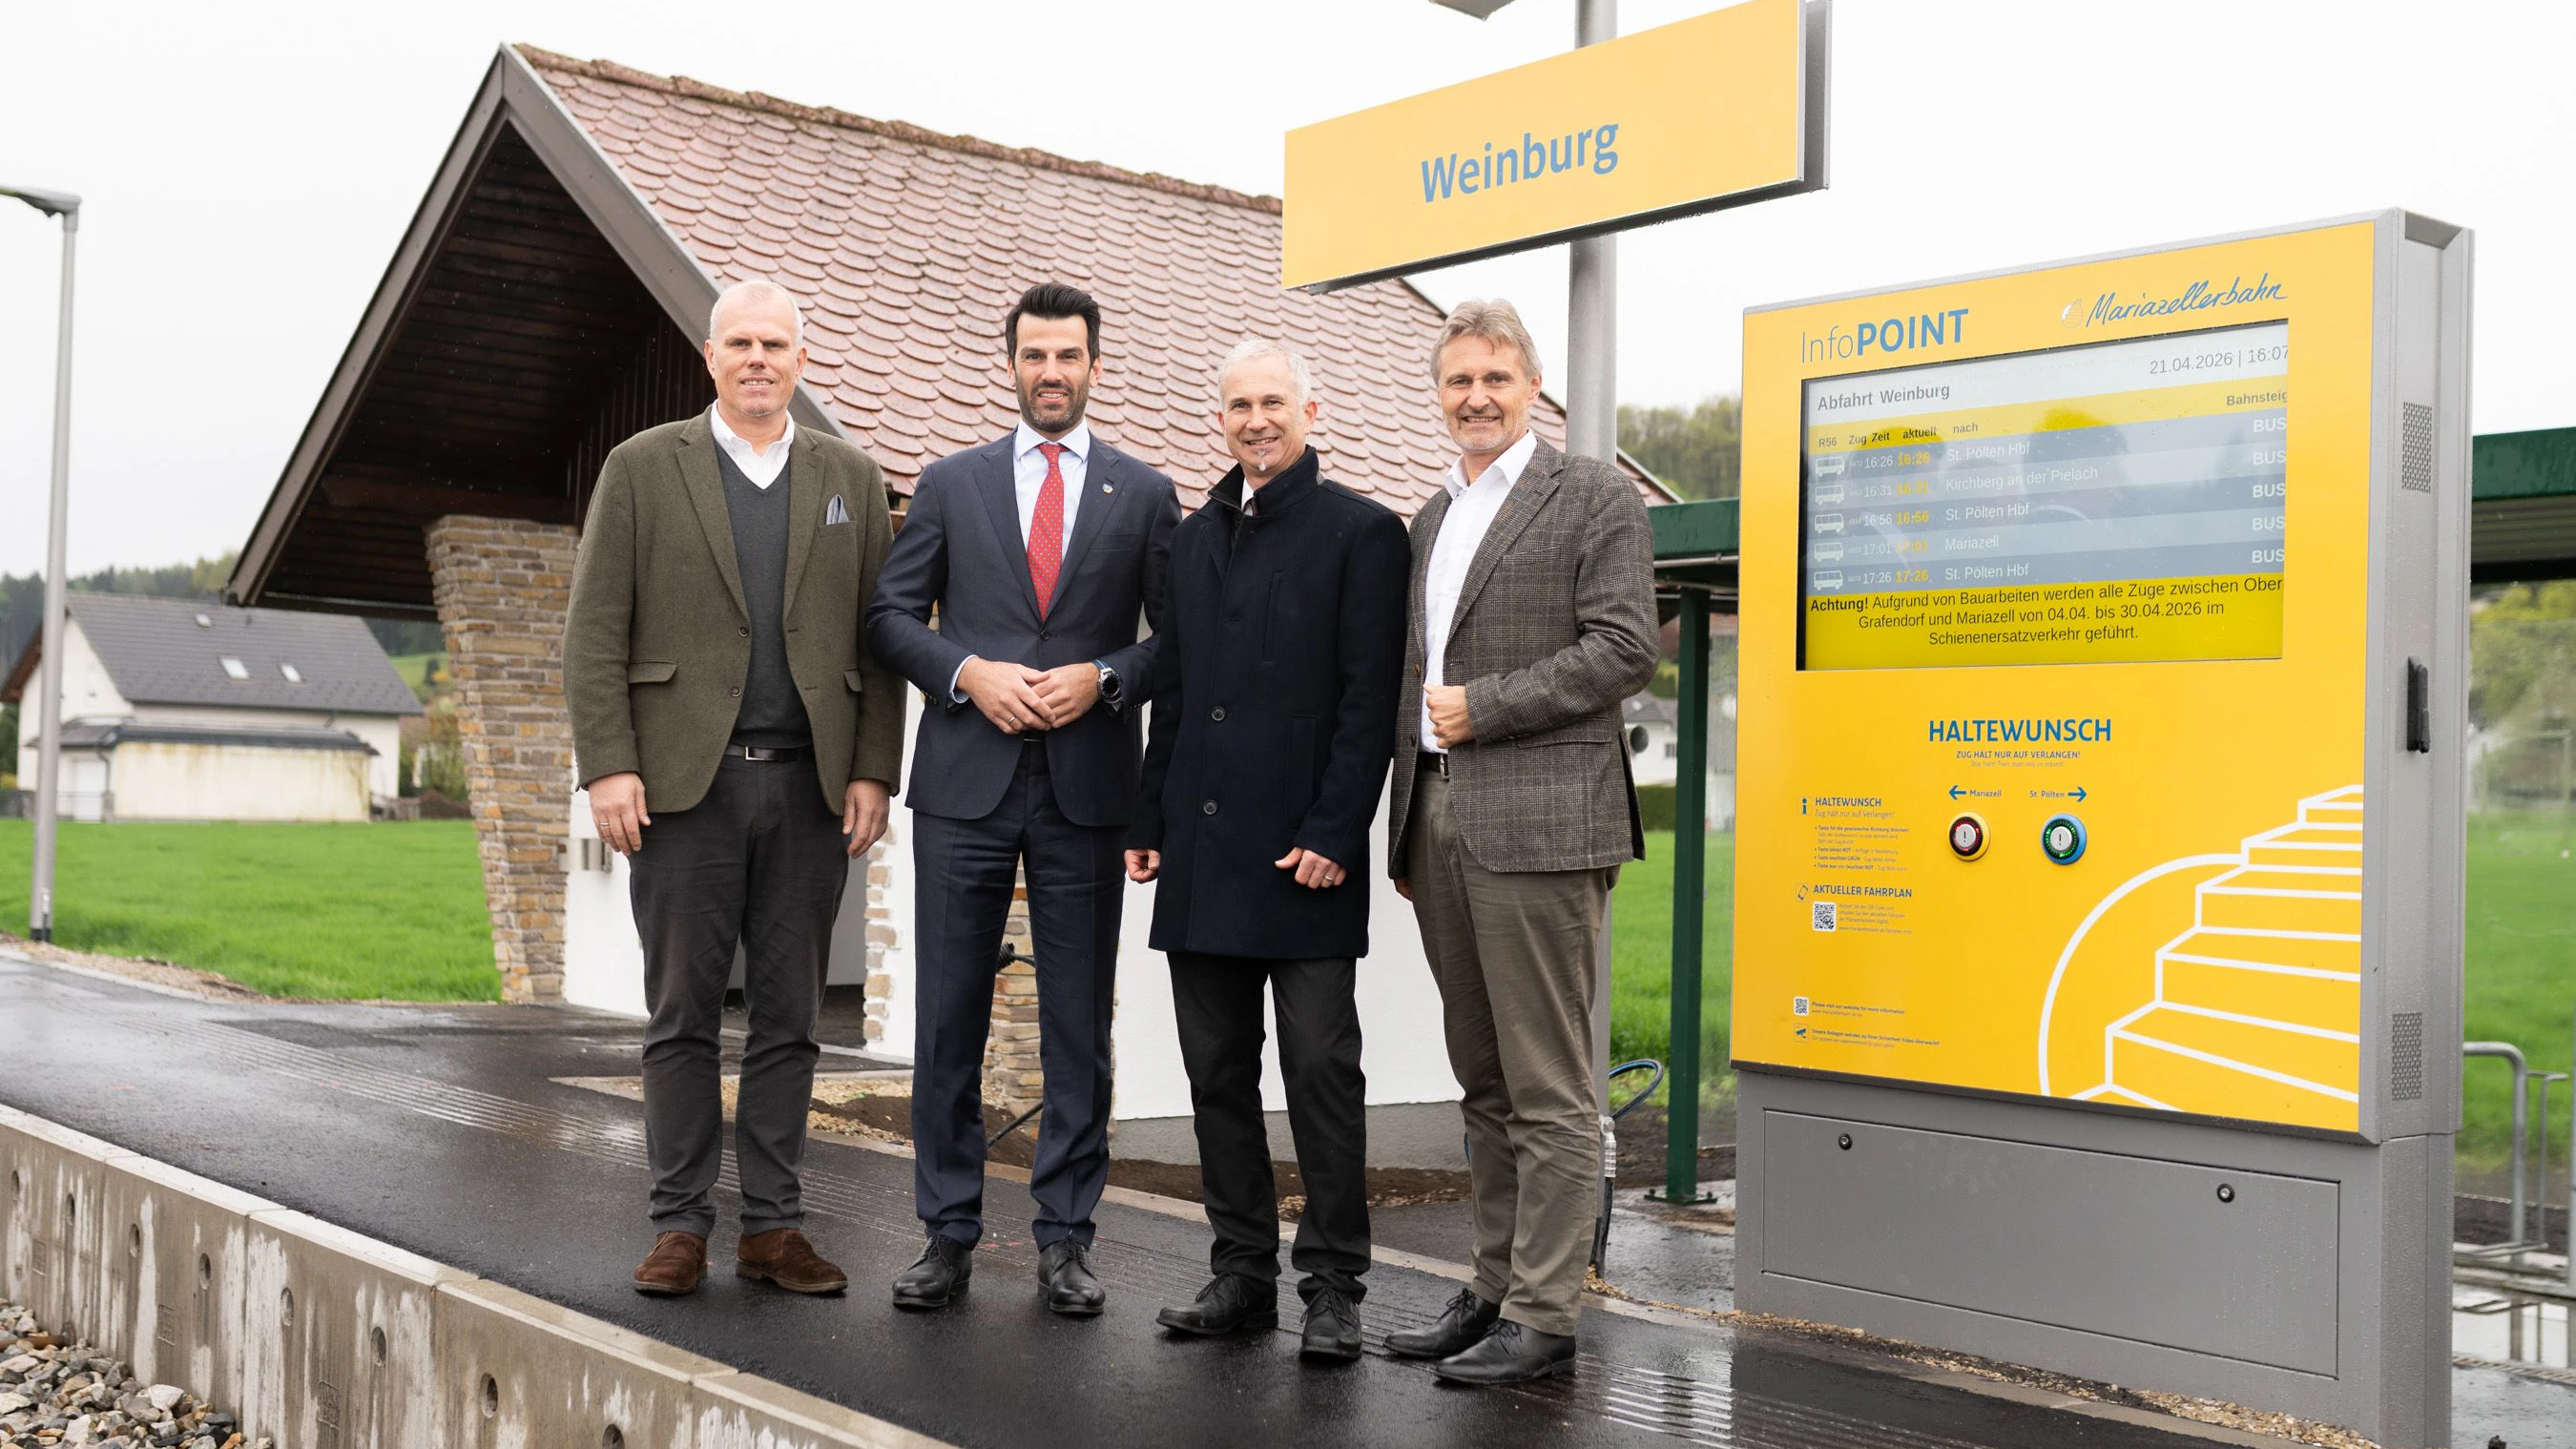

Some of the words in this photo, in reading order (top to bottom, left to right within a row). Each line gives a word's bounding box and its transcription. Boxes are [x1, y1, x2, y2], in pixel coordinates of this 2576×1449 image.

[1421, 123, 1619, 204] Weinburg
[2085, 272, 2289, 328] Mariazellerbahn
[1801, 308, 1969, 363] InfoPOINT
[2150, 351, 2233, 375] 21.04.2026
[2248, 344, 2288, 363] 16:07
[1818, 391, 1873, 411] Abfahrt
[1880, 385, 1950, 404] Weinburg
[1818, 437, 1838, 447] R56
[1848, 434, 1867, 445] Zug
[1871, 431, 1890, 443] Zeit
[1902, 426, 1937, 439] aktuell
[1953, 423, 1978, 434] nach
[2226, 389, 2288, 406] Bahnsteig
[1864, 455, 1893, 469] 16:26
[1946, 447, 1962, 462] St.
[1966, 445, 2005, 460] Pölten
[2008, 441, 2031, 456] Hbf
[2253, 417, 2287, 432] BUS
[1864, 484, 1892, 498] 16:31
[1945, 476, 2004, 491] Kirchberg
[2007, 475, 2023, 486] an
[2025, 471, 2047, 485] der
[2051, 466, 2098, 482] Pielach
[2253, 450, 2286, 465] BUS
[1863, 513, 1893, 527] 16:56
[1945, 507, 1961, 522] St.
[1965, 506, 2004, 520] Pölten
[2007, 503, 2030, 516] Hbf
[2252, 483, 2286, 498] BUS
[1863, 542, 1892, 556] 17:01
[1945, 534, 2000, 550] Mariazell
[2252, 516, 2285, 531] BUS
[1862, 571, 1892, 585] 17:26
[1944, 568, 1961, 581] St.
[1964, 566, 2003, 579] Pölten
[2006, 563, 2029, 577] Hbf
[2252, 549, 2285, 564] BUS
[1810, 596, 1869, 612] Achtung!
[1872, 593, 1929, 611] Aufgrund
[1932, 594, 1956, 606] von
[1960, 590, 2040, 605] Bauarbeiten
[2044, 586, 2094, 601] werden
[2099, 584, 2123, 598] alle
[2128, 583, 2165, 600] Züge
[2170, 579, 2239, 595] zwischen
[2243, 576, 2283, 592] Ober
[1859, 612, 1925, 629] Grafendorf
[1928, 611, 1952, 626] und
[1956, 609, 2015, 625] Mariazell
[2019, 610, 2044, 622] von
[2047, 606, 2090, 621] 04.04.
[2095, 605, 2115, 619] bis
[2120, 601, 2202, 618] 30.04.2026
[2206, 600, 2225, 614] im
[1929, 627, 2081, 646] Schienenersatzverkehr
[2085, 624, 2139, 644] geführt.
[1928, 718, 2111, 742] HALTEWUNSCH
[1956, 751, 1972, 759] ZUG
[1994, 751, 2011, 759] NUR
[2013, 751, 2029, 759] AUF
[2030, 751, 2081, 759] VERLANGEN!
[1815, 797, 1881, 807] HALTEWUNSCH
[1969, 789, 2002, 797] Mariazell
[1813, 884, 1862, 896] AKTUELLER
[1864, 886, 1913, 898] FAHRPLAN
